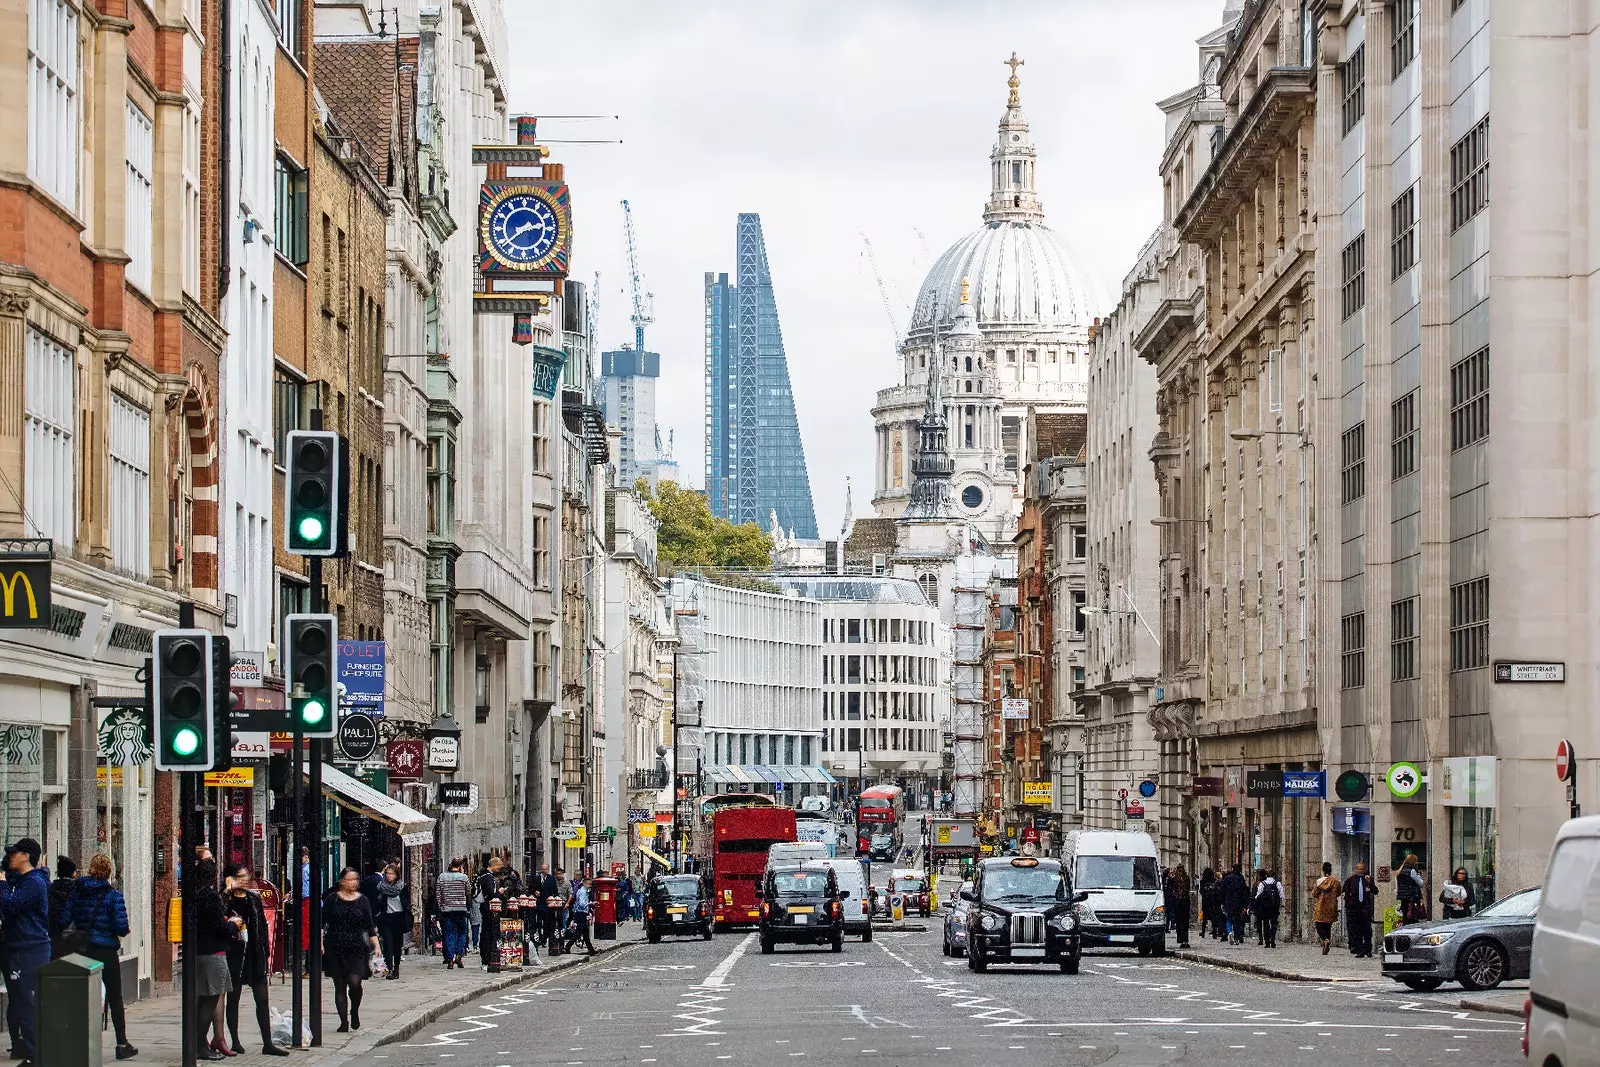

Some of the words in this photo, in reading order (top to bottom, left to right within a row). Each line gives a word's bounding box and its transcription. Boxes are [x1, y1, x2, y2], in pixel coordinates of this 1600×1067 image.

[337, 644, 354, 656] TO
[358, 645, 383, 657] LET
[230, 665, 258, 673] ONDON
[230, 672, 260, 680] OLLEGE
[343, 728, 374, 738] PAUL
[1250, 779, 1281, 790] JONES
[1284, 780, 1319, 788] HALIFAX
[1394, 828, 1415, 840] 70
